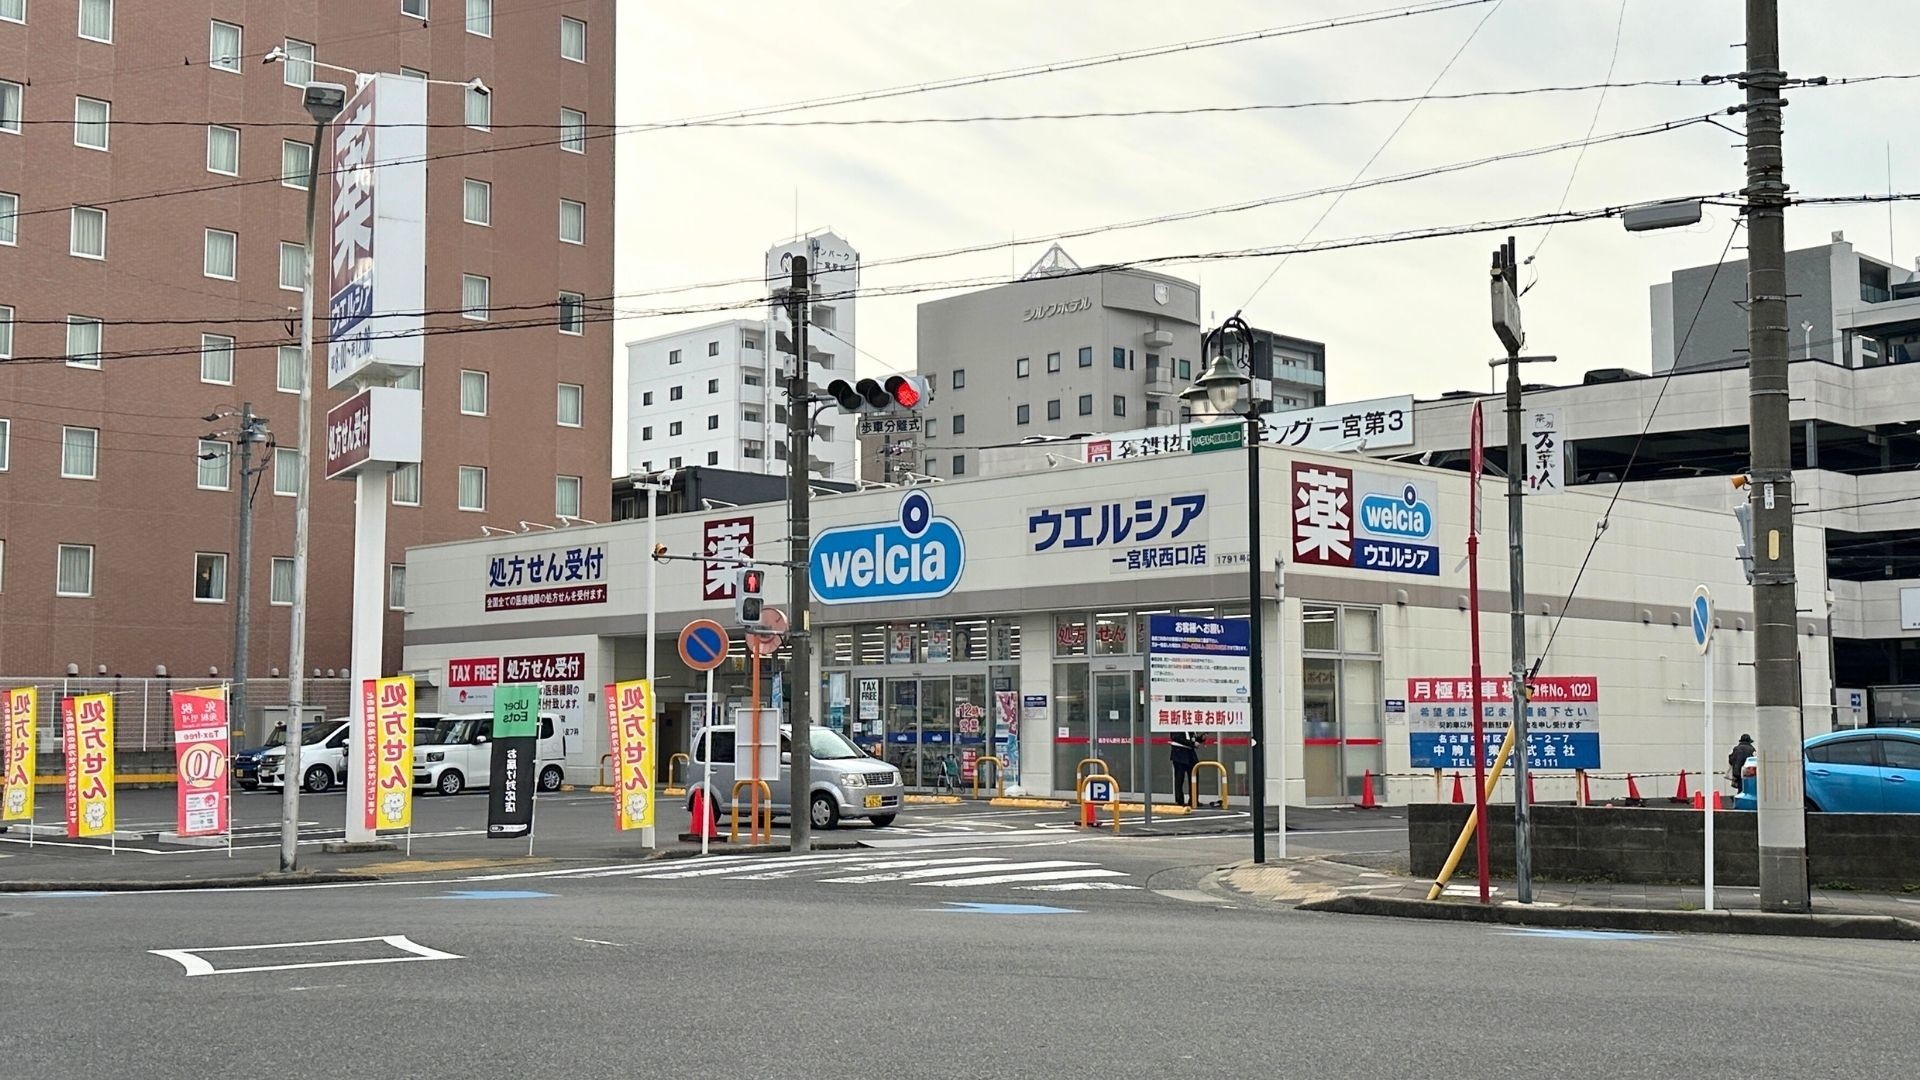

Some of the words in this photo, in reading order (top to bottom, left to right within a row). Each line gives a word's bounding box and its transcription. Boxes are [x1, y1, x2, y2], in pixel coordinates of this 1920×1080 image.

[333, 103, 372, 275] 薬
[332, 278, 371, 335] ウエルシア
[1024, 297, 1092, 322] シルクホテル
[329, 406, 369, 461] 処方せん受付
[861, 419, 920, 433] 歩車分離式
[1029, 494, 1206, 552] ウエルシア
[1294, 468, 1352, 561] 薬
[1365, 484, 1425, 533] welcia
[706, 522, 750, 596] 薬
[820, 495, 946, 588] welcia
[1112, 544, 1206, 570] 一宮駅西口店
[1364, 544, 1429, 569] ウエルシア
[489, 547, 604, 587] 処方せん受付
[451, 664, 471, 682] TAX
[474, 663, 498, 681] FREE
[507, 656, 580, 680] 処方せん受付
[1159, 710, 1243, 725] 無断駐車お断り!!
[1093, 783, 1106, 798] P
